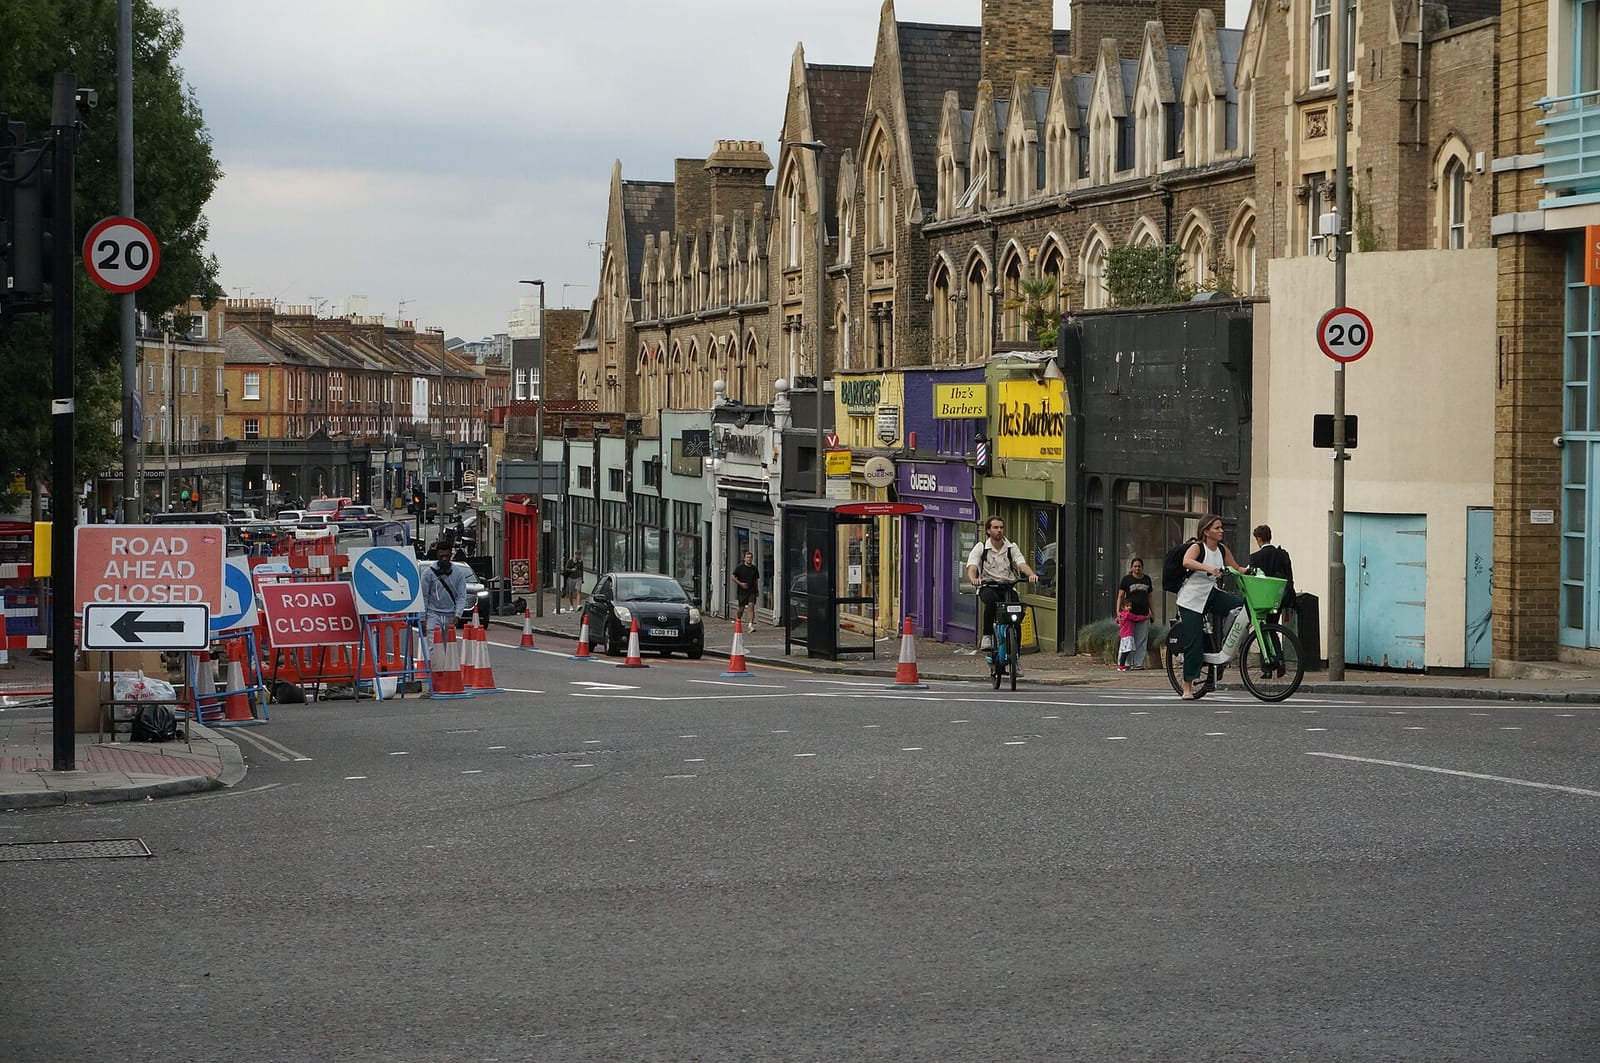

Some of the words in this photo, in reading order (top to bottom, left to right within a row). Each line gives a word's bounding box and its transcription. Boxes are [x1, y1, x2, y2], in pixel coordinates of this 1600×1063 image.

[97, 240, 150, 271] 20
[1328, 324, 1366, 346] 20
[841, 380, 880, 404] BARKERS
[951, 387, 974, 399] Ibz's
[942, 403, 983, 415] Barbers
[1021, 399, 1064, 438] Barbers
[998, 402, 1021, 437] Ibz's
[827, 436, 837, 447] V
[910, 473, 937, 492] QUEENS
[111, 537, 188, 556] ROAD
[103, 560, 195, 579] AHEAD
[94, 584, 203, 603] CLOSED
[281, 593, 336, 608] ROAD
[275, 616, 354, 633] CLOSED
